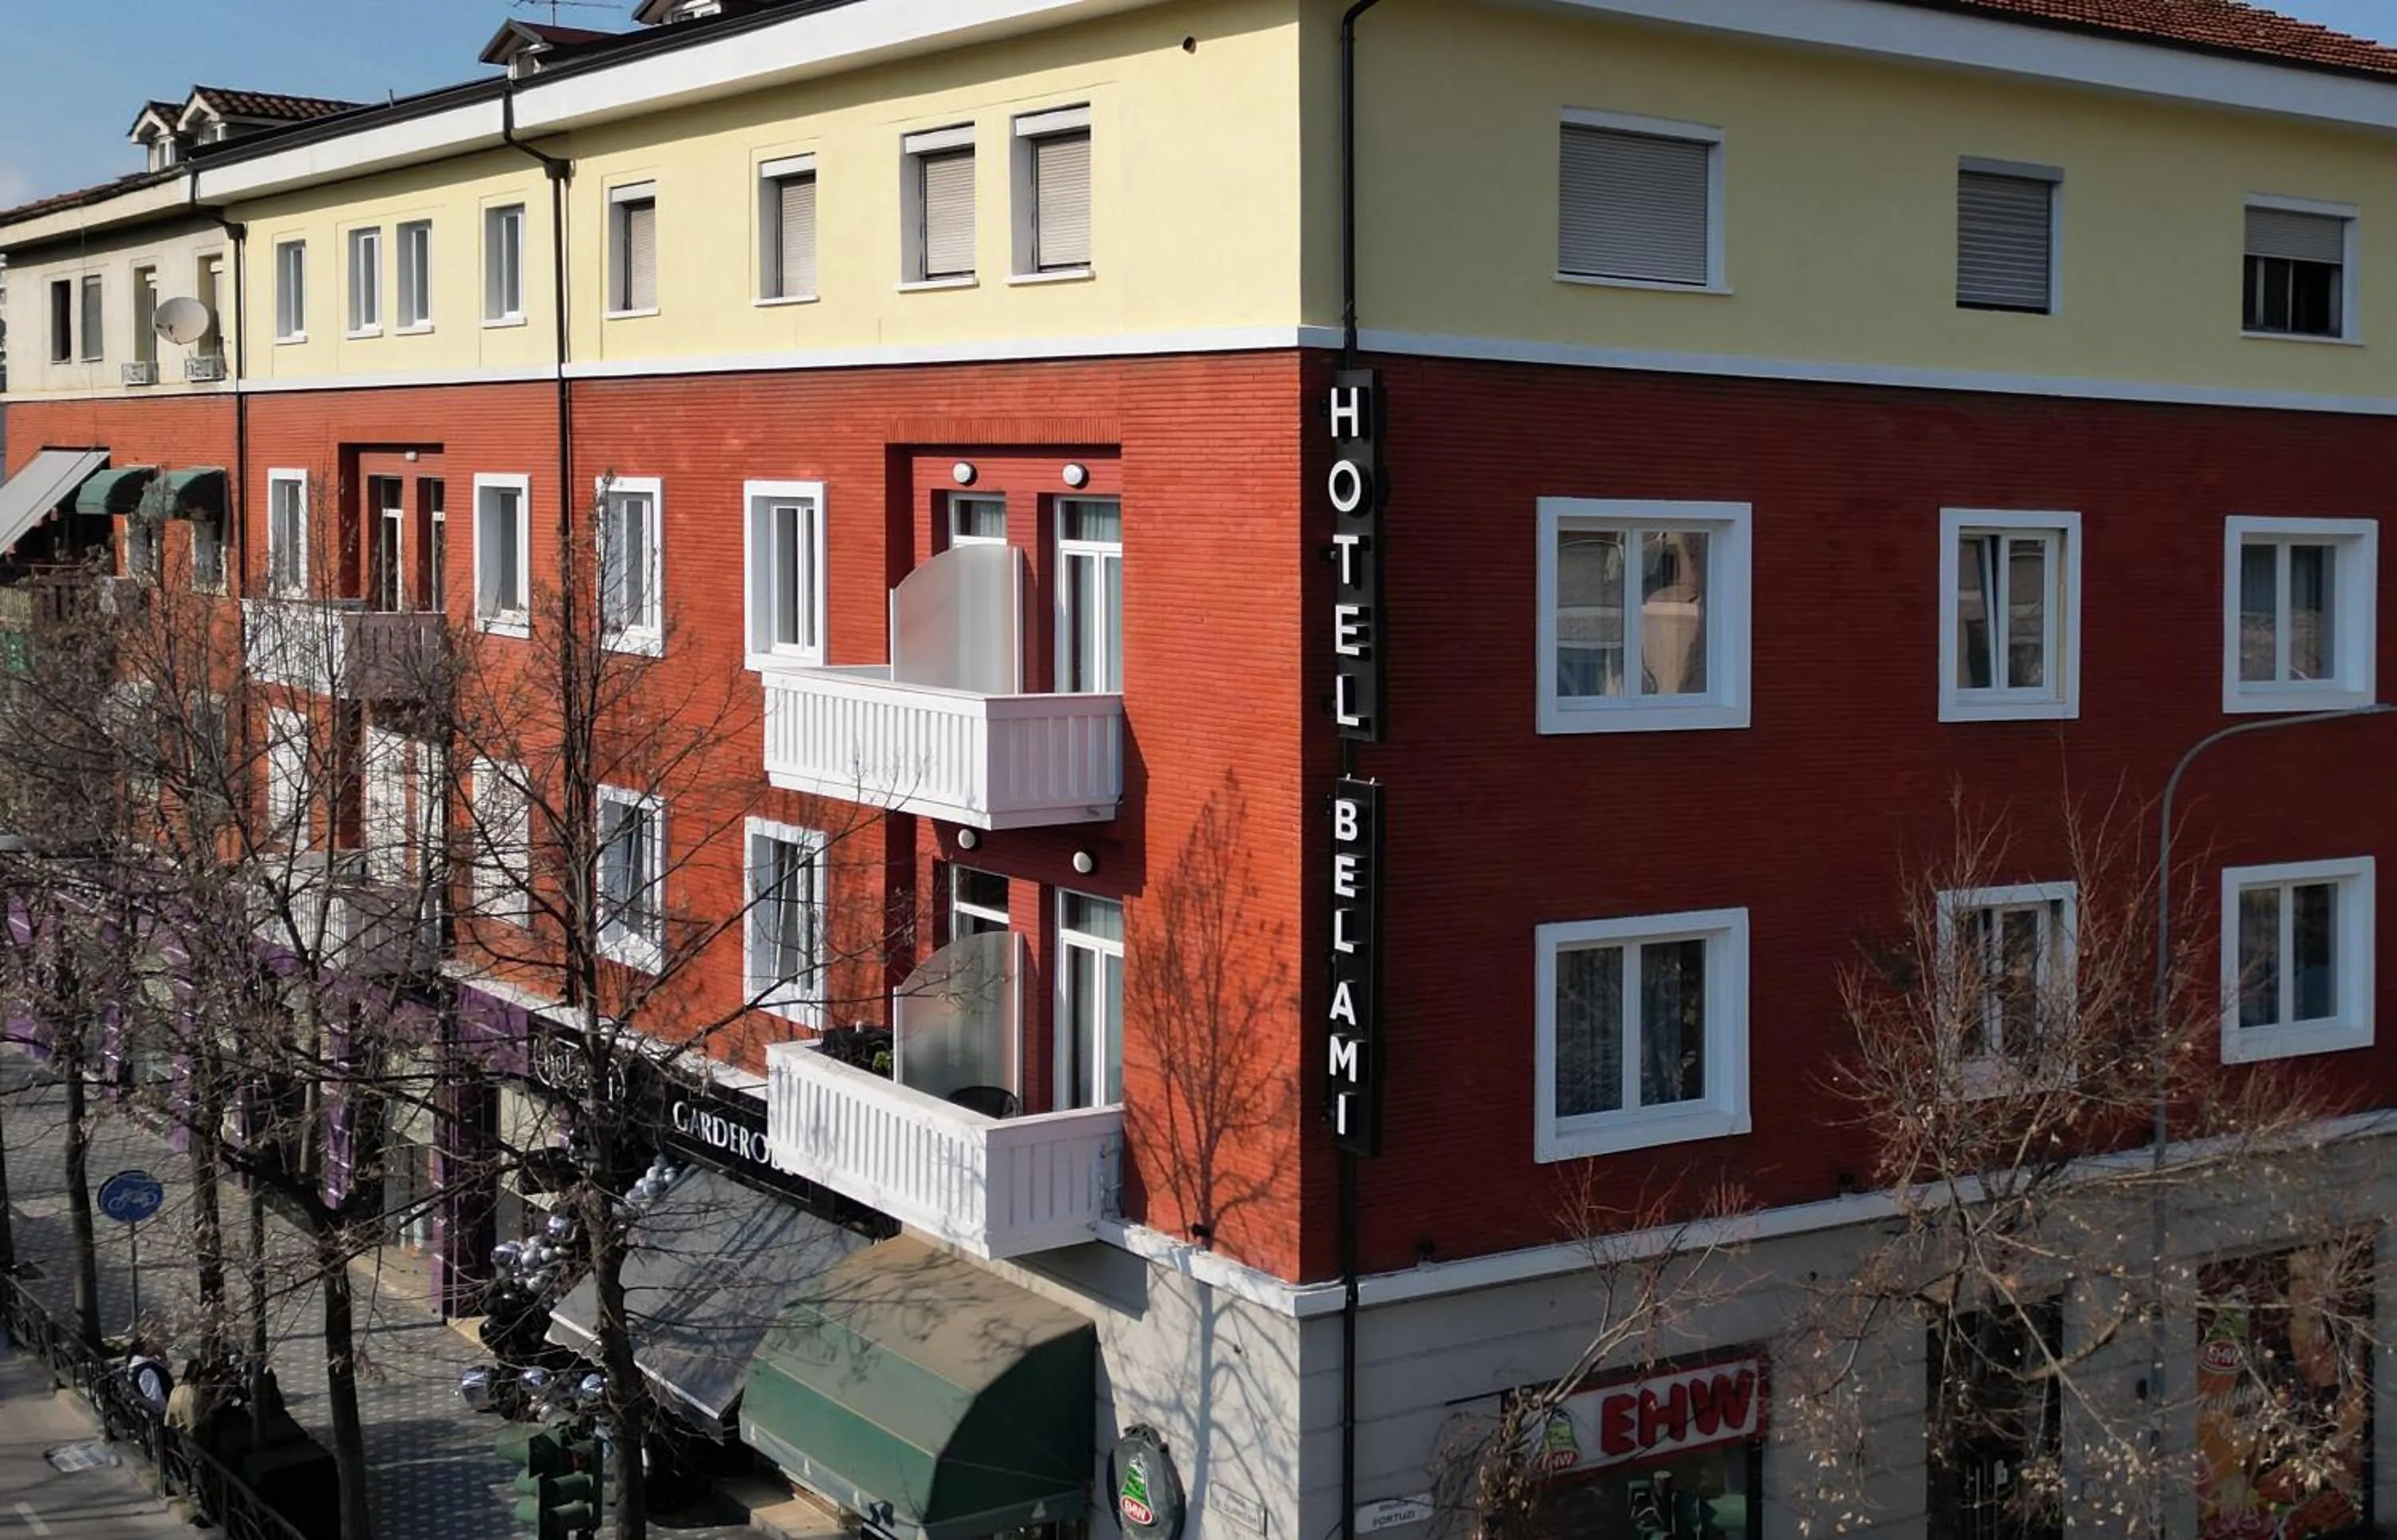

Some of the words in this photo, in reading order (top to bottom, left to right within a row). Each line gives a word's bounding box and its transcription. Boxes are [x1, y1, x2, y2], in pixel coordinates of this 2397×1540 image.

[1328, 387, 1361, 726] HOTEL
[673, 1101, 793, 1176] GARDERO
[1601, 1368, 1755, 1456] EHW
